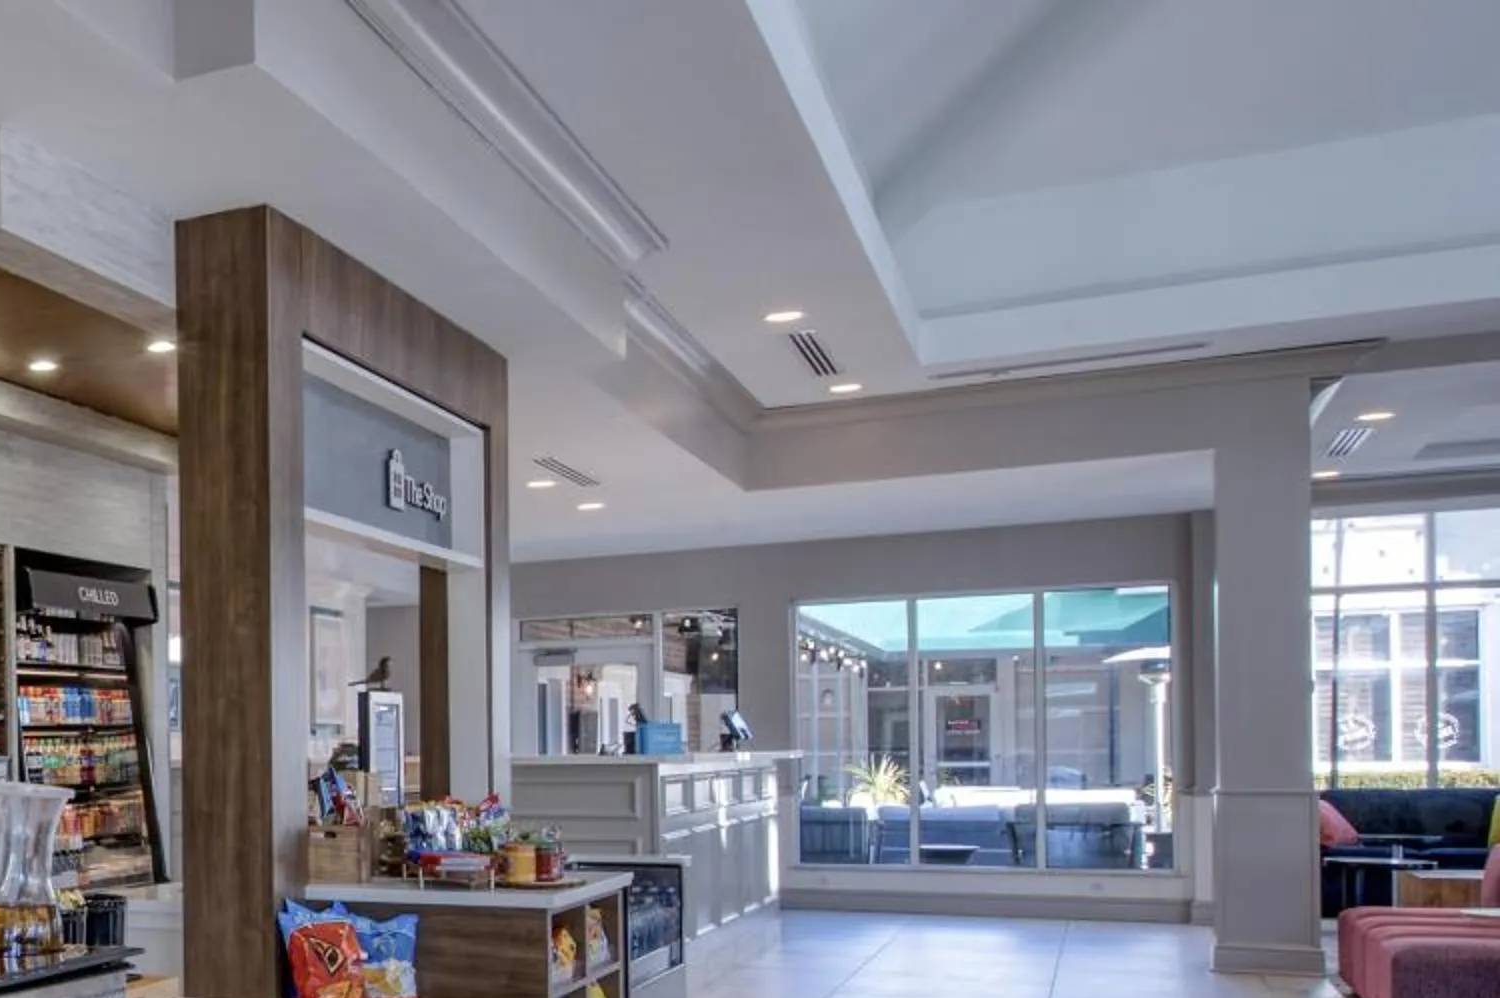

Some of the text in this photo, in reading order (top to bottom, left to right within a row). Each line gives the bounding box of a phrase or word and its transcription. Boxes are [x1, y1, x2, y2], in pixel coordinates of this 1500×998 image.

[403, 474, 447, 521] The Shop
[78, 586, 119, 606] CHILLED
